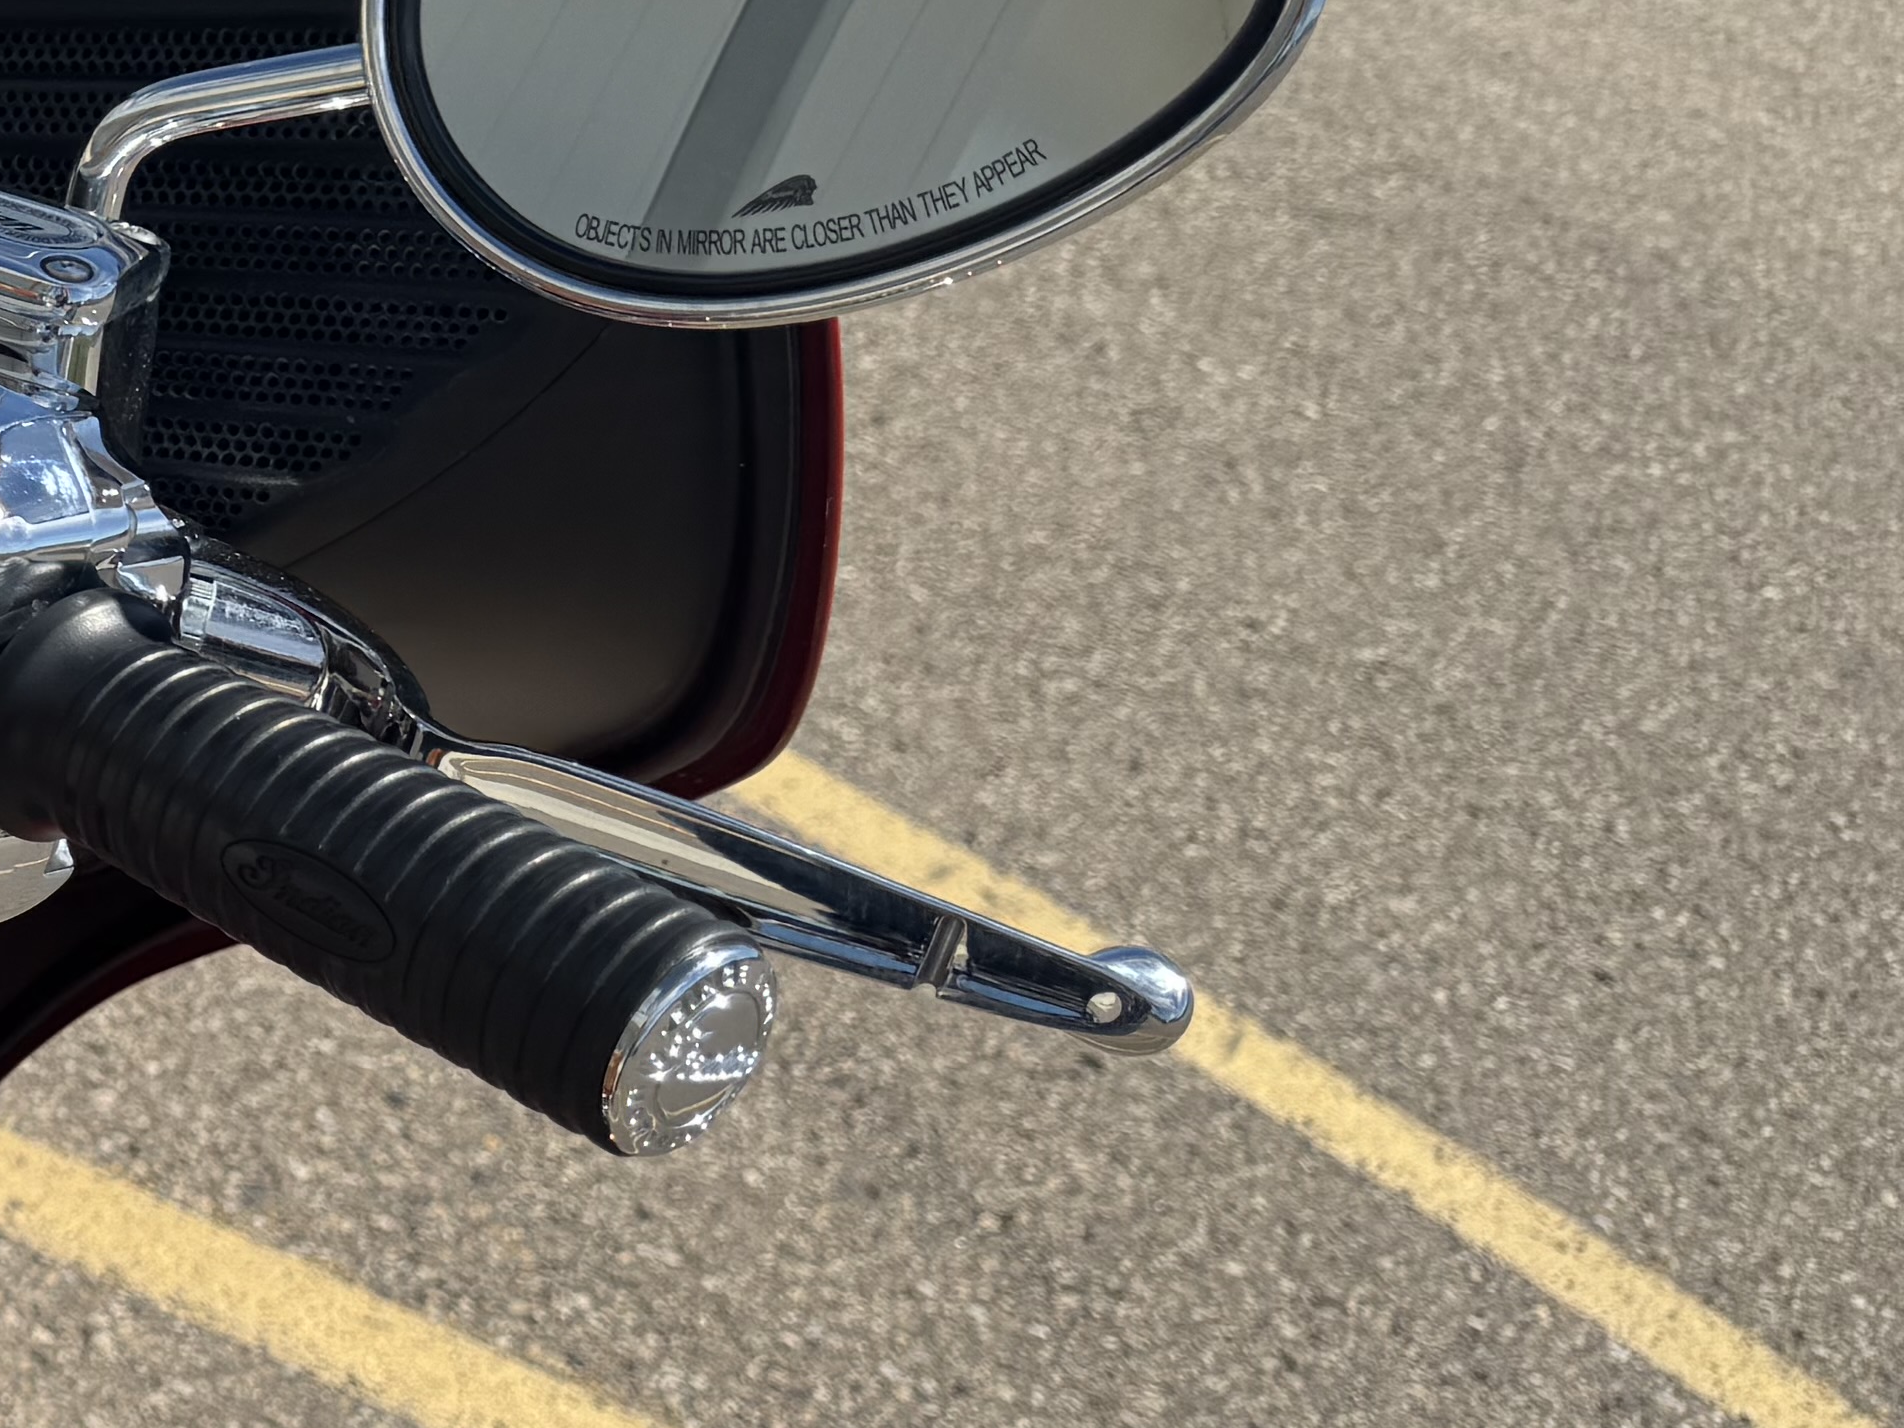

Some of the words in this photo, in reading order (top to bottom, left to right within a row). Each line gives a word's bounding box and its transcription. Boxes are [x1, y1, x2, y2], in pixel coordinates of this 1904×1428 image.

[575, 213, 652, 253] OBJECTS
[656, 228, 672, 254] IN
[677, 228, 746, 256] MIRROR
[751, 227, 787, 255] ARE
[791, 213, 865, 250] CLOSER
[864, 197, 917, 235] THAN
[917, 176, 969, 218] THEY
[973, 138, 1047, 198] APPEAR
